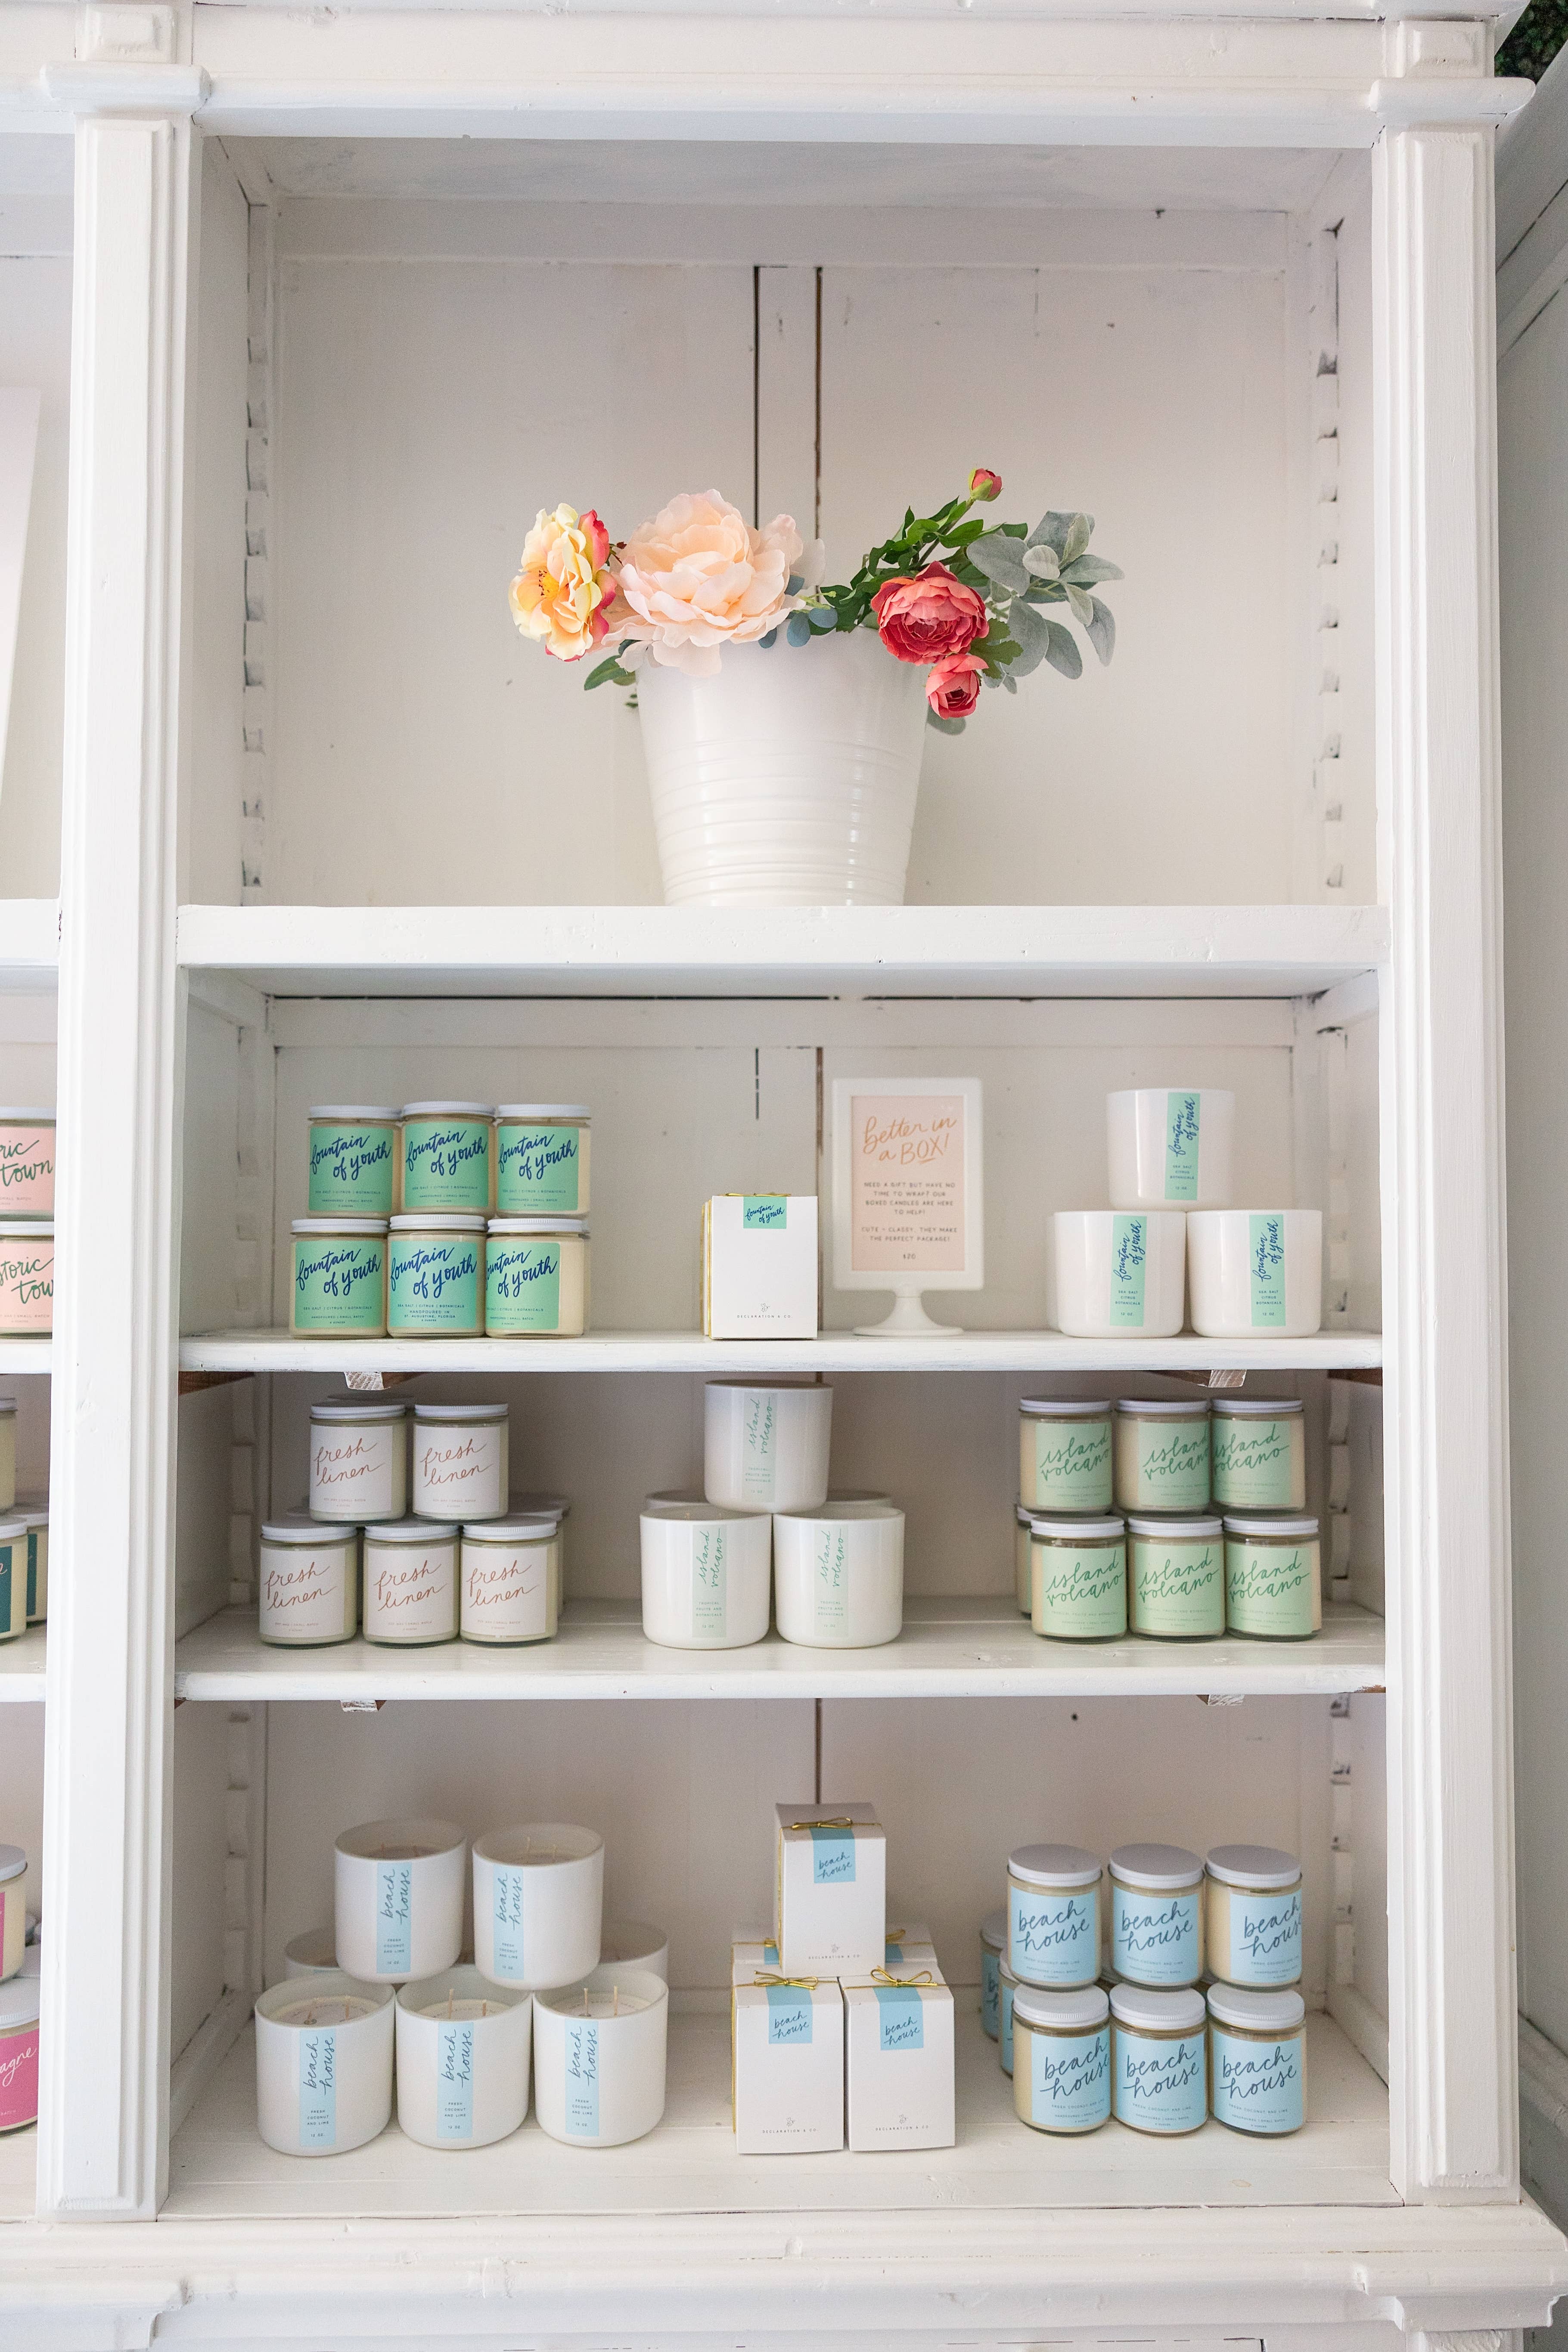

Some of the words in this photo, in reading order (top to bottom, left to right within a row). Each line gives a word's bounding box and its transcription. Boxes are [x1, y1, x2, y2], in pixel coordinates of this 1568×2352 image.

[932, 1117, 957, 1132] in
[1185, 1097, 1199, 1130] youth
[406, 1130, 467, 1171] fountain
[879, 1150, 896, 1161] a
[901, 1133, 949, 1164] BOX!
[1168, 1110, 1186, 1157] fountain
[1183, 1129, 1197, 1140] of
[310, 1135, 370, 1174] fountain
[333, 1157, 346, 1181] of
[351, 1141, 391, 1180] youth
[431, 1152, 444, 1176] of
[448, 1137, 487, 1175] youth
[499, 1134, 554, 1173] fountain
[519, 1156, 531, 1180] of
[536, 1140, 577, 1179] youth
[0, 1160, 53, 1186] town
[745, 1205, 774, 1221] fountain
[759, 1214, 765, 1223] of
[766, 1207, 785, 1223] youth
[1130, 1220, 1145, 1254] youth
[1267, 1219, 1284, 1253] youth
[296, 1249, 361, 1291] fountain
[324, 1272, 338, 1296] of
[342, 1254, 381, 1295] youth
[391, 1247, 454, 1291] fountain
[413, 1272, 428, 1298] of
[433, 1254, 477, 1298] youth
[1113, 1232, 1132, 1282] fountain
[1129, 1253, 1143, 1265] of
[1253, 1232, 1271, 1282] fountain
[1267, 1253, 1282, 1264] of
[11, 1279, 53, 1304] tow
[498, 1273, 509, 1297] of
[512, 1256, 557, 1297] youth
[747, 1399, 760, 1449] island
[760, 1396, 772, 1454] volcano
[314, 1438, 377, 1476] fresh
[420, 1439, 486, 1477] fresh
[1040, 1425, 1109, 1468] island
[317, 1463, 385, 1486] linen
[424, 1464, 494, 1487] linen
[696, 1531, 709, 1584] island
[711, 1528, 723, 1588] volcano
[818, 1530, 830, 1583] island
[832, 1529, 845, 1587] volcano
[1046, 1550, 1119, 1592] island
[1138, 1547, 1213, 1589] island
[1229, 1551, 1302, 1588] island
[264, 1562, 330, 1600] fresh
[267, 1586, 337, 1610] linen
[373, 1560, 441, 1600] fresh
[378, 1583, 448, 1611] linen
[466, 1560, 532, 1598] fresh
[469, 1585, 538, 1608] linen
[1047, 1571, 1124, 1607] volcano
[1140, 1569, 1219, 1603] volcano
[1229, 1573, 1310, 1602] volcano
[817, 1862, 852, 1879] house
[819, 1852, 850, 1869] beach
[381, 1869, 395, 1918] beach
[396, 1870, 410, 1925] house
[496, 1873, 508, 1922] beach
[509, 1876, 522, 1931] house
[1019, 1900, 1086, 1932] beach
[1122, 1901, 1189, 1931] beach
[1016, 1919, 1089, 1952] house
[1119, 1920, 1192, 1951] house
[773, 2022, 809, 2039] house
[775, 2011, 807, 2029] beach
[884, 2027, 920, 2045] house
[886, 2016, 917, 2036] beach
[303, 2036, 318, 2088] beach
[319, 2037, 334, 2096] house
[441, 2029, 456, 2081] beach
[457, 2031, 472, 2088] house
[568, 2026, 582, 2078] beach
[583, 2029, 597, 2086] house
[1045, 2036, 1107, 2080] beach
[1127, 2044, 1196, 2078] beach
[1223, 2046, 1293, 2078] beach
[1123, 2062, 1199, 2098] house
[1220, 2065, 1296, 2099] house
